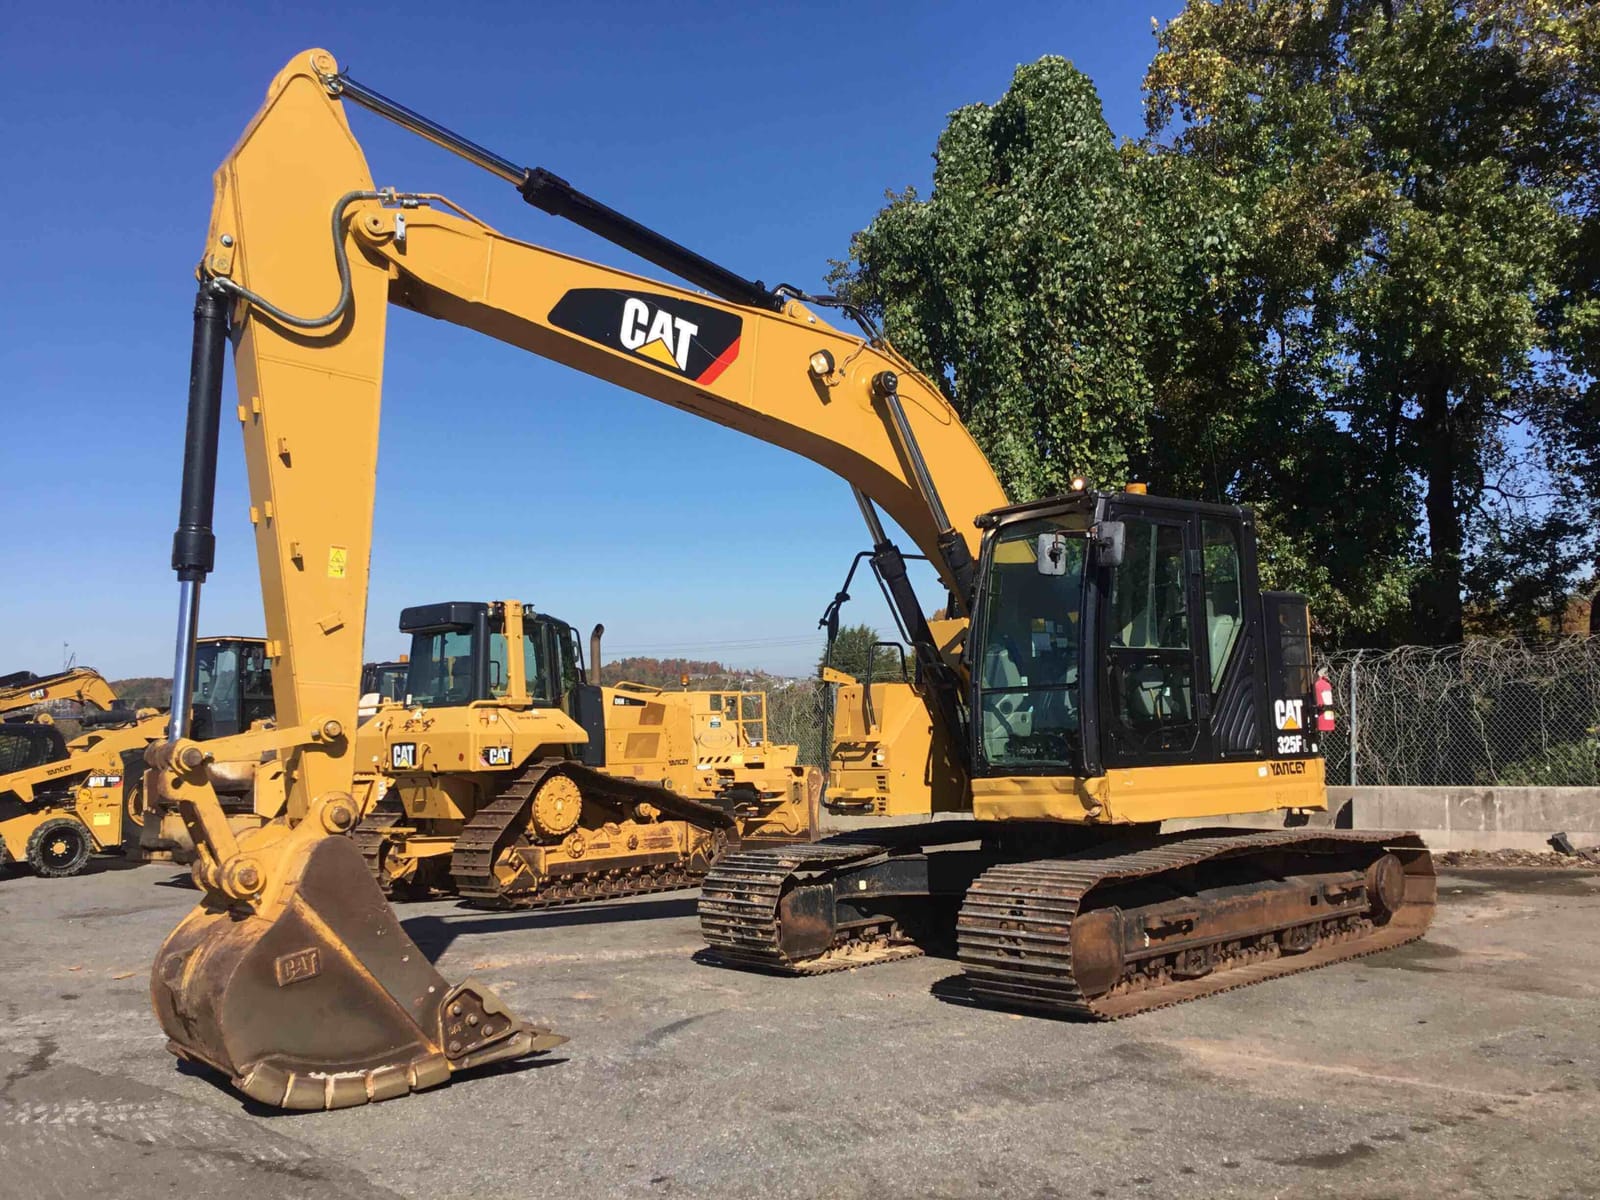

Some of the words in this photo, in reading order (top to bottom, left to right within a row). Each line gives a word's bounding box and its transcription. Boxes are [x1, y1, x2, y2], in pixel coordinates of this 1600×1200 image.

[620, 297, 698, 371] CAT
[30, 689, 44, 699] CAT
[1274, 699, 1303, 730] CAT
[1277, 735, 1302, 754] 325F
[393, 744, 415, 768] CAT
[489, 748, 510, 765] CAT
[46, 765, 72, 776] YANCEY
[1270, 761, 1306, 776] YANCEY
[285, 952, 317, 979] CAT
